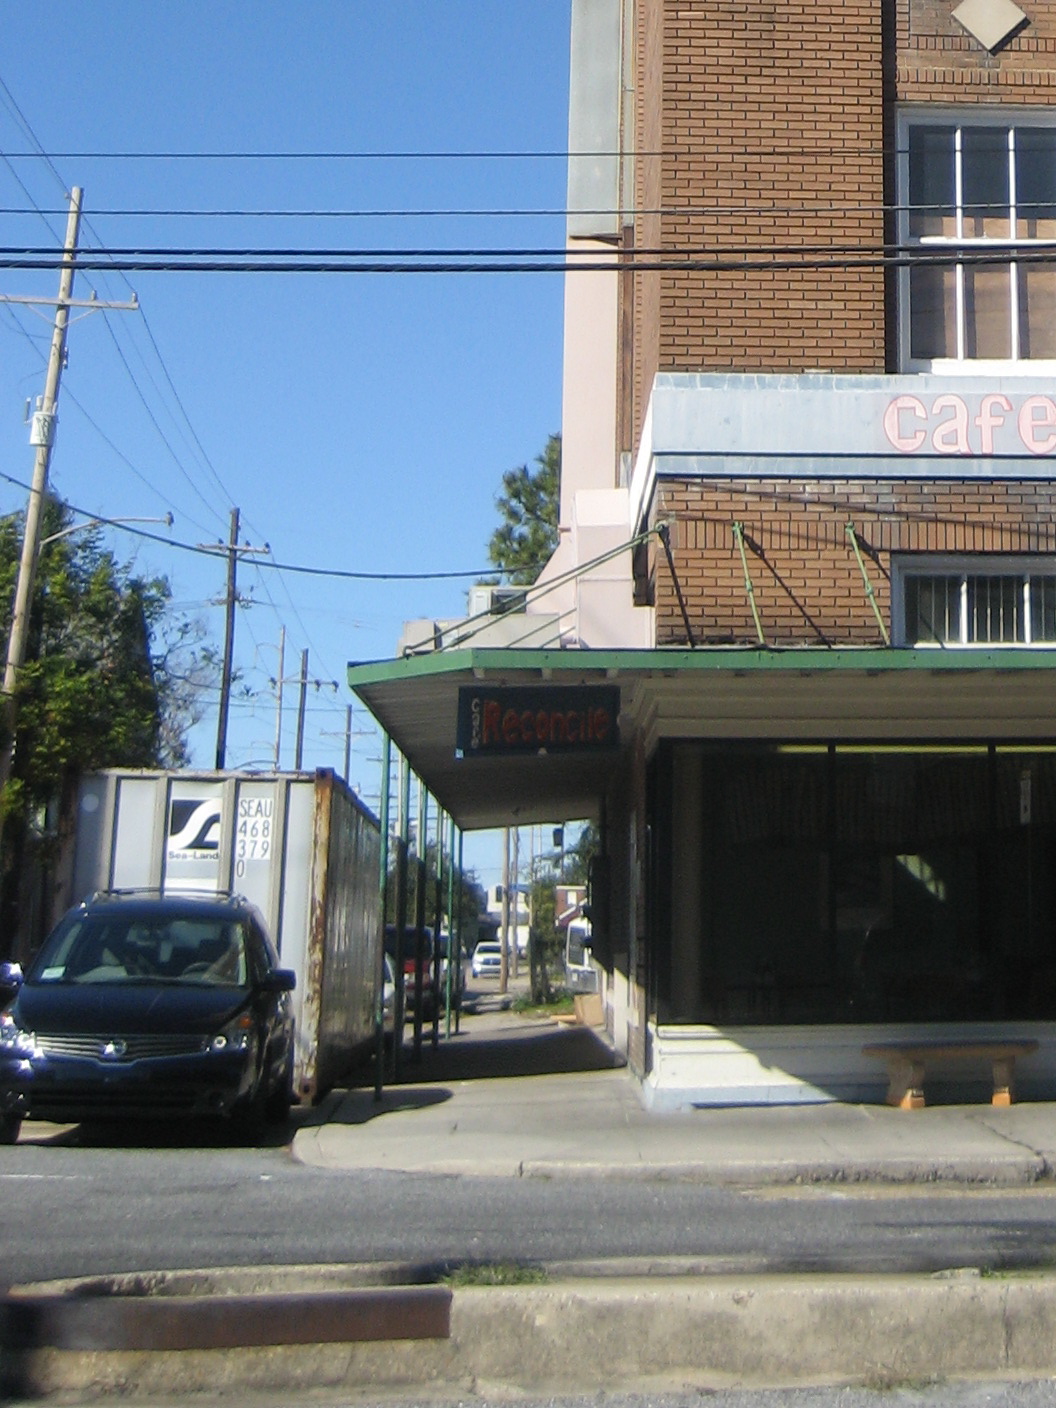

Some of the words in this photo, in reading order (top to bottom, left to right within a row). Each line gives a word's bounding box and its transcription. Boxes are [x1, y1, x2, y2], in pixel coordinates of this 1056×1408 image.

[482, 699, 609, 745] Reconcile
[239, 799, 272, 818] SEAU
[238, 820, 270, 838] 468
[169, 850, 219, 860] Sea-Land
[238, 840, 269, 858] 379
